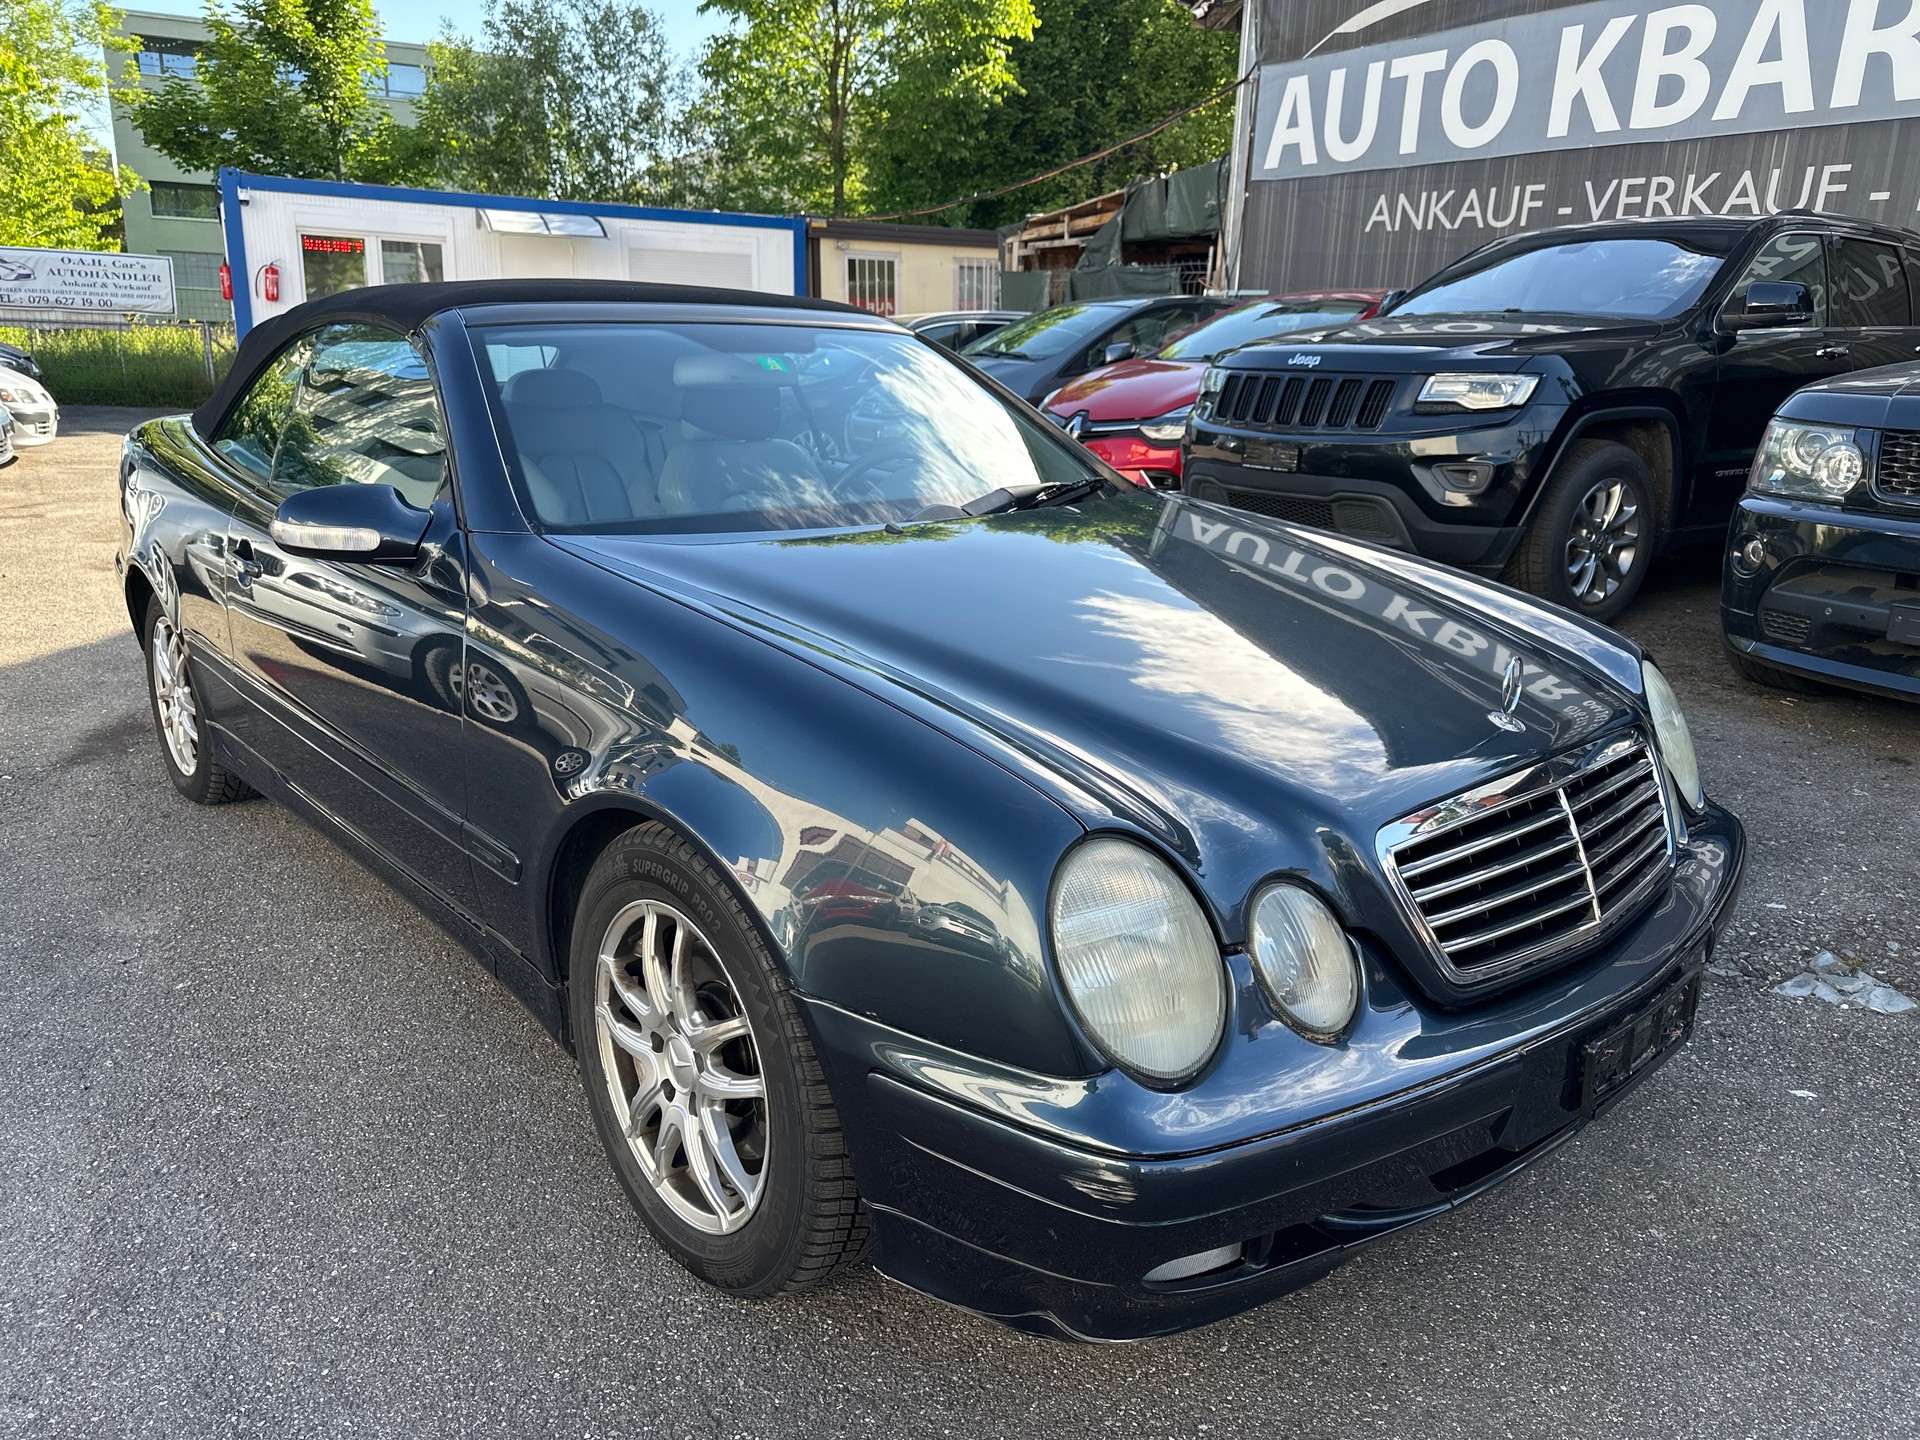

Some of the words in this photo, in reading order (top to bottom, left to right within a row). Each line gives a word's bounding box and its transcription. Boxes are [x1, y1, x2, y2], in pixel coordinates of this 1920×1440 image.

[1264, 39, 1518, 170] AUTO
[1547, 0, 1920, 138] KBAR
[1364, 184, 1546, 232] ANKAUF
[1585, 164, 1852, 222] VERKAUF
[60, 256, 107, 267] O.A.H.
[47, 267, 162, 283] AUTOHÄNDLER
[61, 279, 98, 288] Ankauf
[113, 282, 152, 291] Verkauf
[28, 295, 49, 305] 079
[55, 296, 75, 306] 627
[81, 297, 93, 307] 19
[98, 298, 113, 308] 00
[1288, 353, 1321, 368] Jeep
[632, 858, 689, 895] SUPERGRIP
[691, 892, 714, 923] PRO
[711, 920, 722, 933] 2
